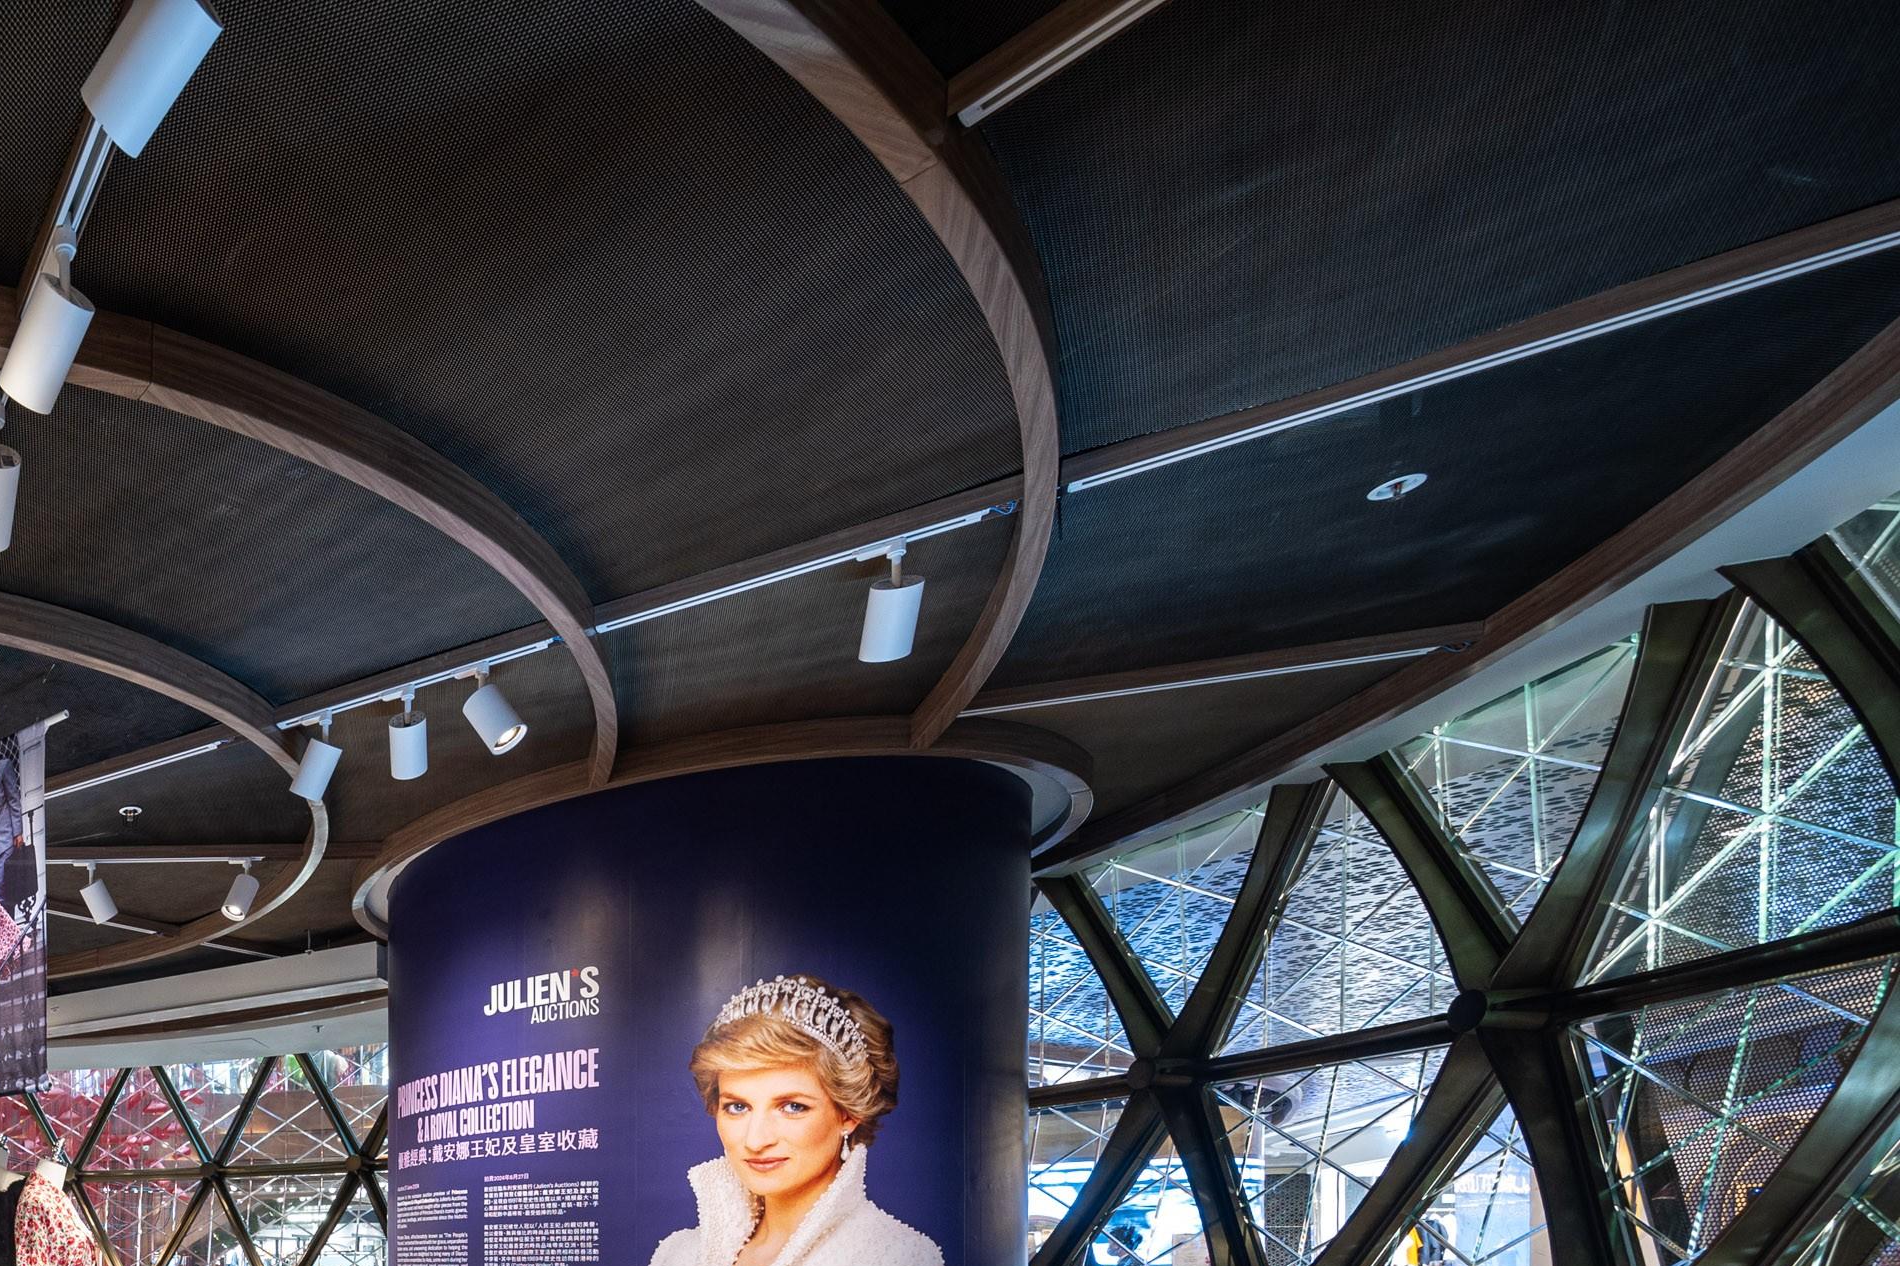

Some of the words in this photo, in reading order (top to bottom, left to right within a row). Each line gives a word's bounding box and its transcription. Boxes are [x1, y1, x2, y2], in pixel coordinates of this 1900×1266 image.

[530, 997, 600, 1025] AUCTIONS
[397, 1074, 438, 1119] PRINCESS
[439, 1062, 499, 1108] DIANA'S
[502, 1048, 600, 1098] ELEGANCE
[417, 1116, 424, 1144] &
[424, 1115, 431, 1142] A
[431, 1108, 459, 1140] ROYAL
[460, 1099, 535, 1138] COLLECTION
